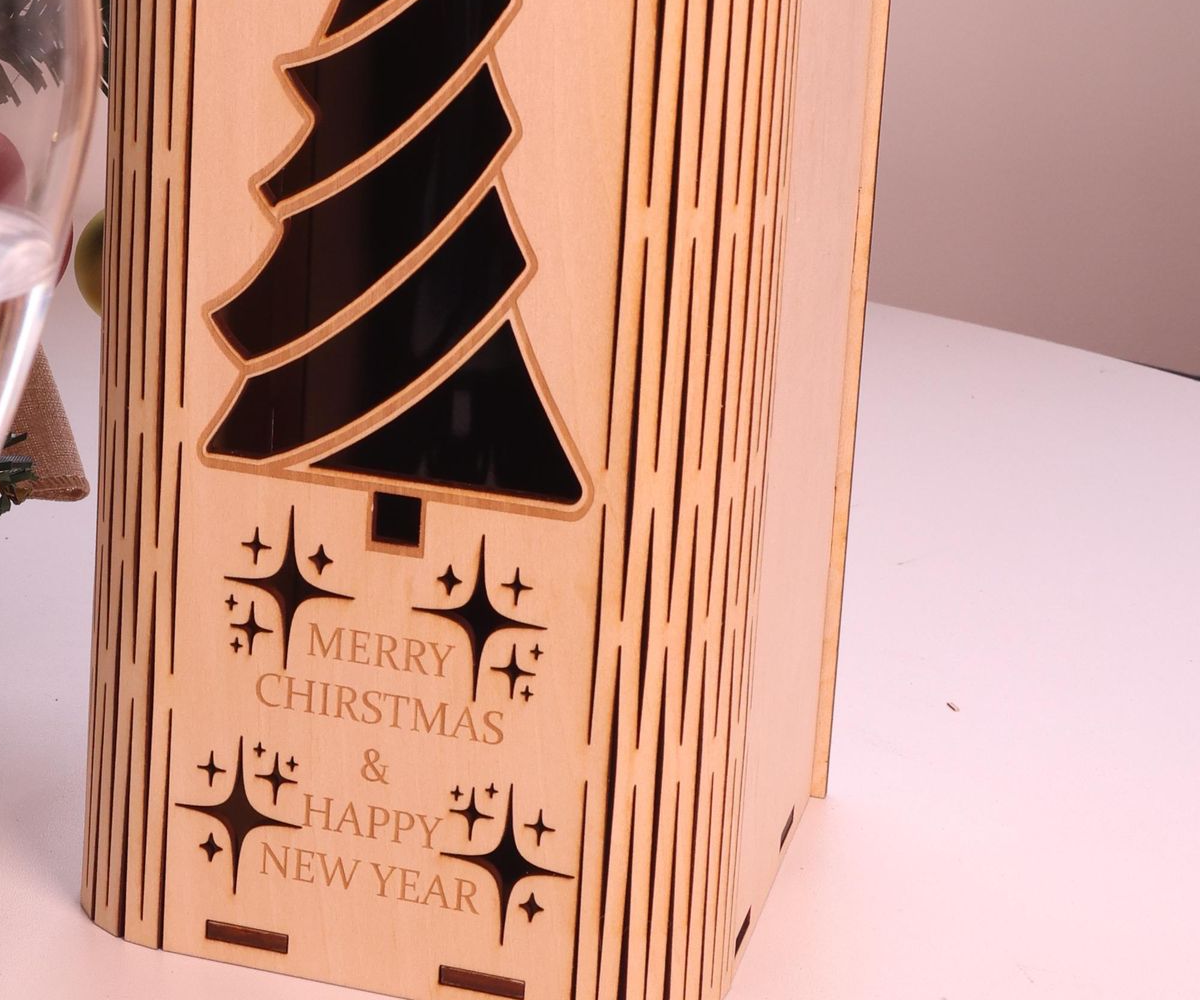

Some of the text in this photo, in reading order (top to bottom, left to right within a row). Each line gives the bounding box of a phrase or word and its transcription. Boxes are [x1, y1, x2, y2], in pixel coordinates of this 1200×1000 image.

[306, 622, 456, 678] MERRY
[255, 672, 505, 745] CHIRSTMAS
[360, 748, 390, 785] &
[300, 793, 444, 850] HAPPY
[259, 842, 480, 915] NEW YEAR
